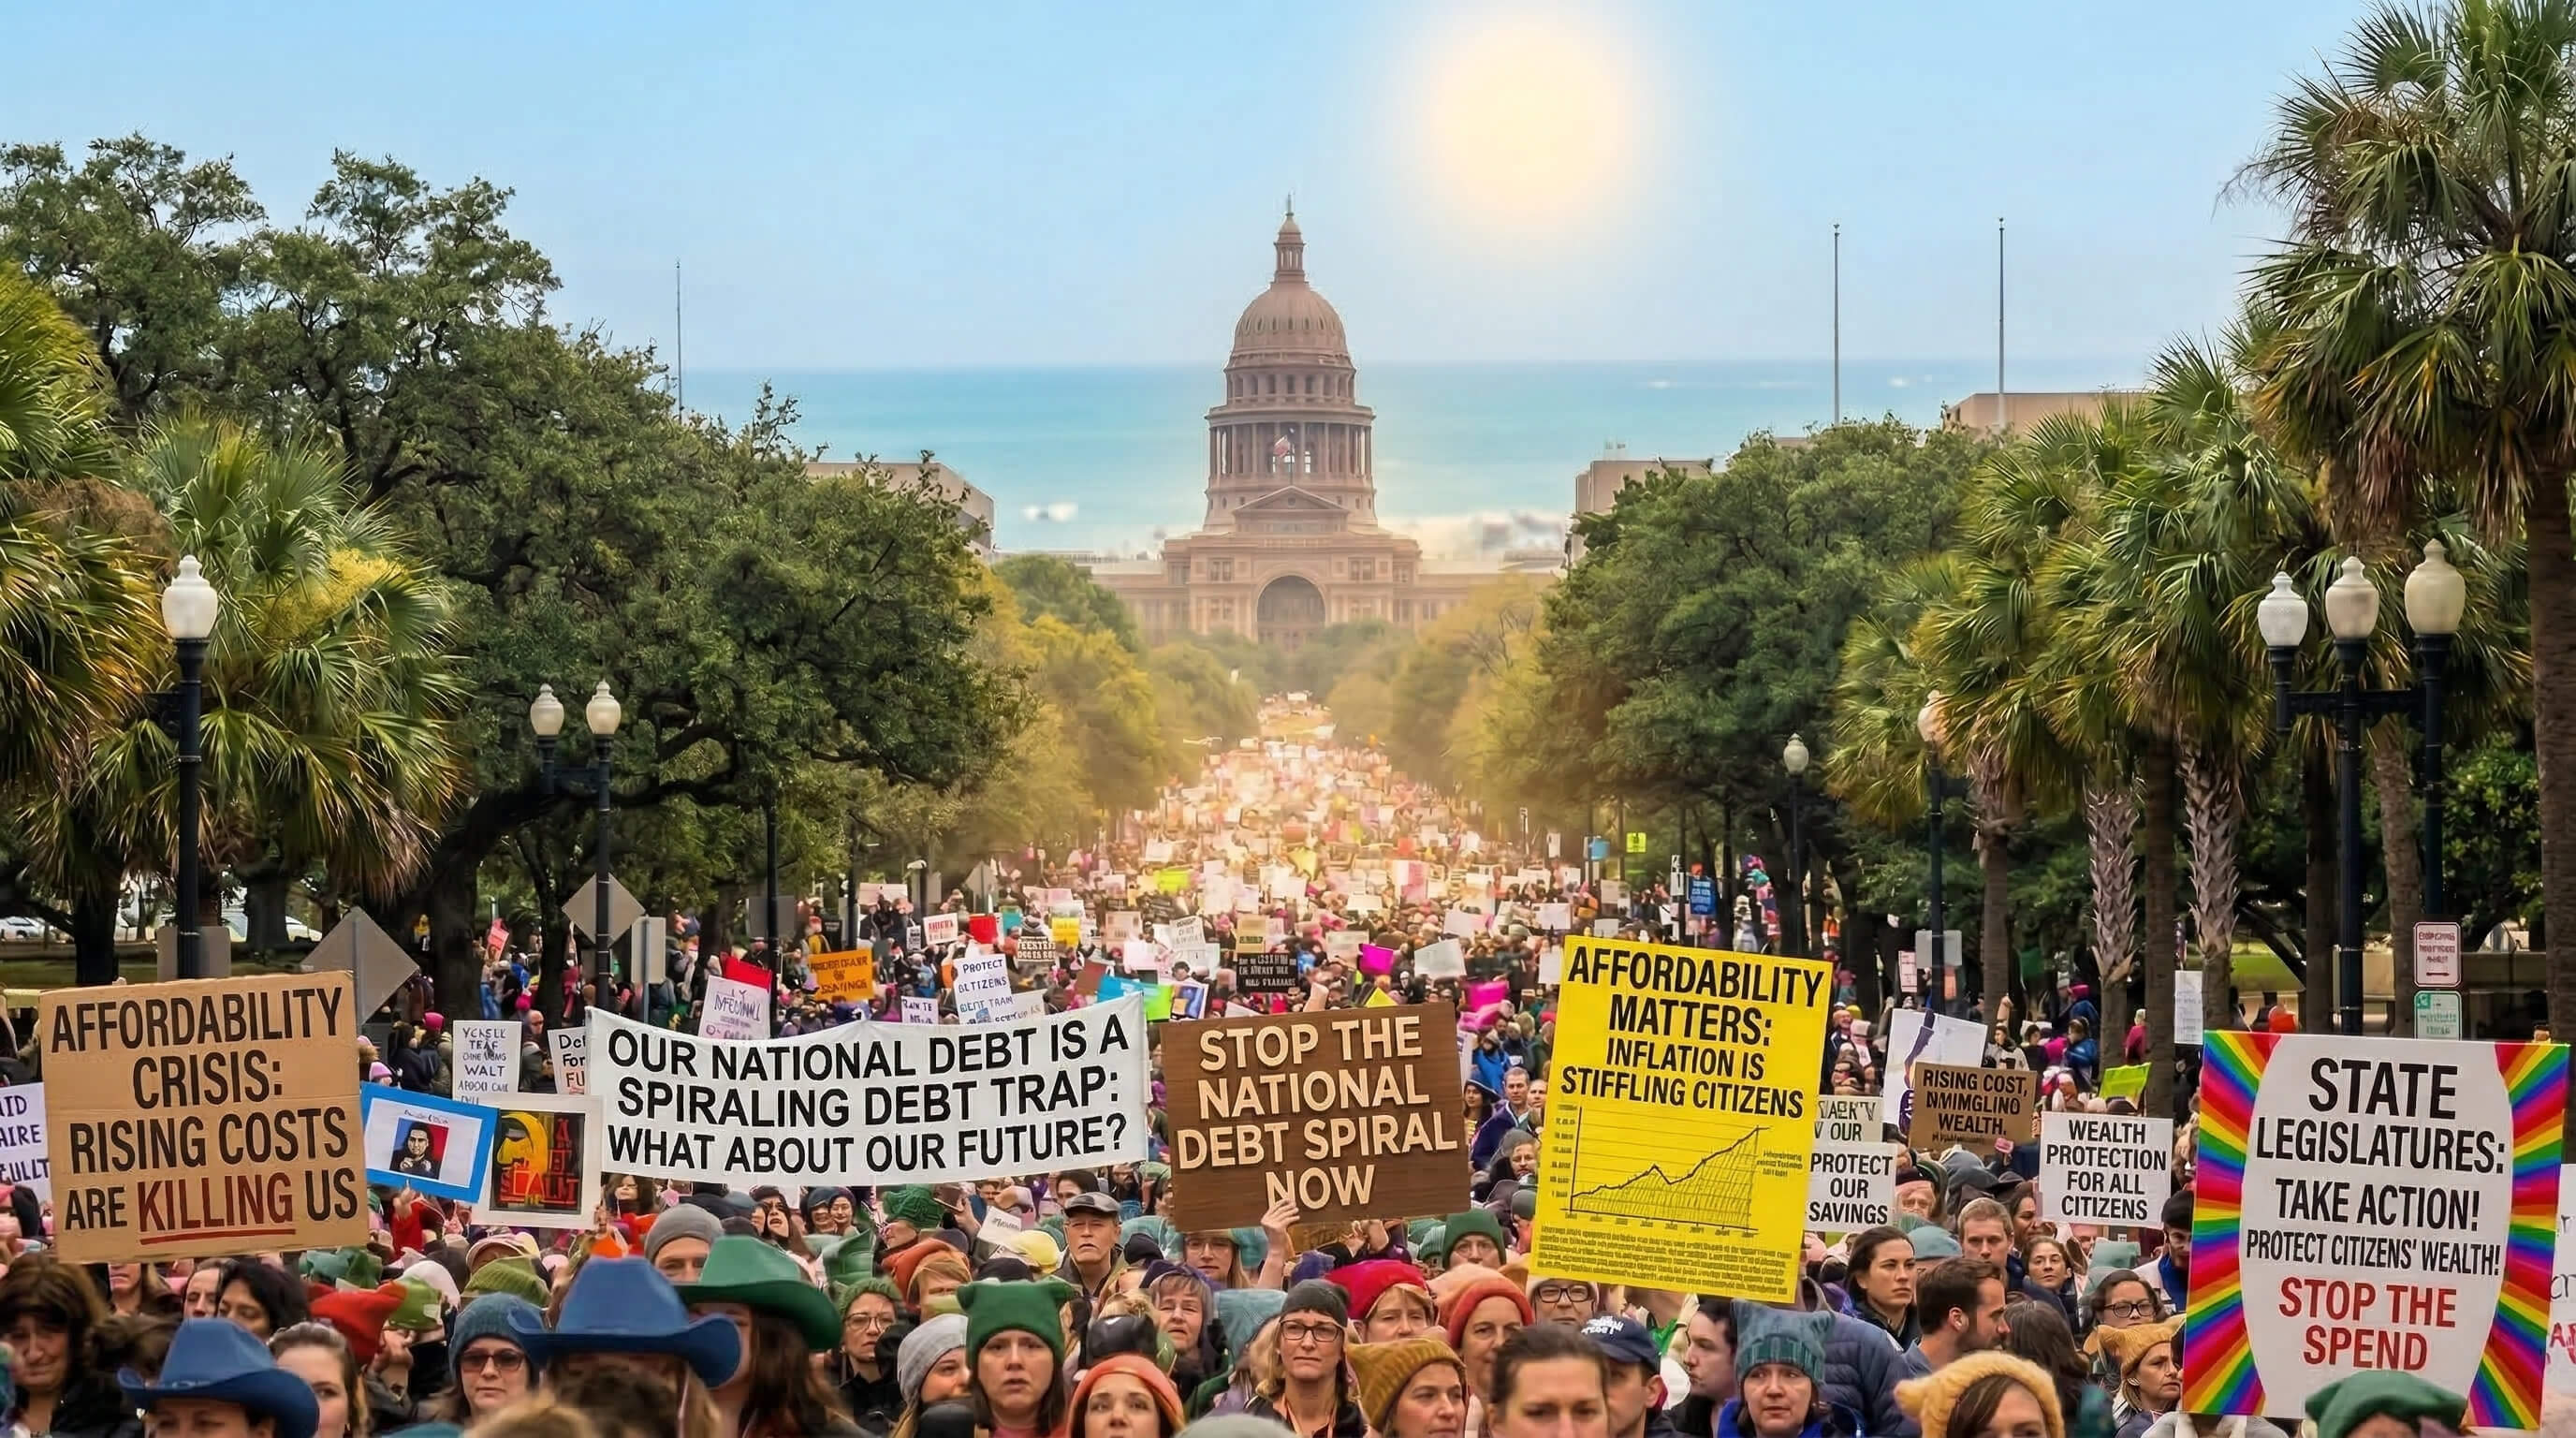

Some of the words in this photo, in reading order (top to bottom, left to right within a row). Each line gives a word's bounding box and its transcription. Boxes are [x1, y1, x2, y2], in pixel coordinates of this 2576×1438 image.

[962, 959, 1003, 974] PROTECT
[1568, 946, 1824, 1007] AFFORDABILITY
[51, 987, 342, 1053] AFFORDABILITY
[1201, 1024, 1318, 1070] STOP
[1332, 1016, 1422, 1060] THE
[1609, 994, 1771, 1047] MATTERS:
[464, 1065, 506, 1077] WALT
[608, 1029, 697, 1077] OUR
[712, 1041, 915, 1080] NATIONAL
[929, 1028, 1036, 1074] DEBT
[1051, 1020, 1086, 1062] IS
[1100, 1014, 1129, 1054] A
[1606, 1038, 1734, 1078] INFLATION
[1742, 1052, 1764, 1079] IS
[133, 1049, 282, 1109] CRISIS:
[618, 1077, 848, 1127] SPIRALING
[866, 1081, 976, 1125] DEBT
[990, 1065, 1118, 1116] TRAP:
[1198, 1064, 1429, 1120] NATIONAL
[1561, 1066, 1685, 1106] STIFFLING
[1693, 1081, 1803, 1118] CITIZENS
[1924, 1069, 1977, 1090] RISING
[1983, 1075, 2027, 1096] COST,
[2309, 1058, 2457, 1120] STATE
[70, 1116, 206, 1174] RISING
[219, 1107, 348, 1165] COSTS
[608, 1125, 714, 1169] WHAT
[724, 1137, 854, 1173] ABOUT
[867, 1134, 945, 1172] OUR
[959, 1113, 1127, 1167] FUTURE?
[1178, 1123, 1288, 1168] DEBT
[1305, 1112, 1456, 1159] SPIRAL
[1939, 1113, 2006, 1135] WEALTH.
[2069, 1120, 2145, 1144] WEALTH
[2257, 1117, 2504, 1173] LEGISLATURES:
[1810, 1153, 1893, 1175] PROTECT
[2047, 1145, 2166, 1170] PROTECTION
[2068, 1171, 2104, 1192] FOR
[2109, 1174, 2144, 1195] ALL
[65, 1186, 127, 1230] ARE
[138, 1172, 292, 1232] KILLING
[305, 1167, 358, 1221] US
[1266, 1165, 1375, 1210] NOW
[1809, 1202, 1887, 1225] SAVINGS
[1831, 1178, 1868, 1198] OUR
[2062, 1196, 2147, 1220] CITIZENS
[2276, 1179, 2349, 1223] TAKE
[2357, 1184, 2479, 1231] ACTION!
[2247, 1229, 2327, 1263] PROTECT
[2332, 1235, 2417, 1269] CITIZENS'
[2422, 1240, 2500, 1275] WEALTH!
[2279, 1276, 2377, 1322] STOP
[2385, 1284, 2456, 1328] THE
[2303, 1323, 2429, 1371] SPEND
